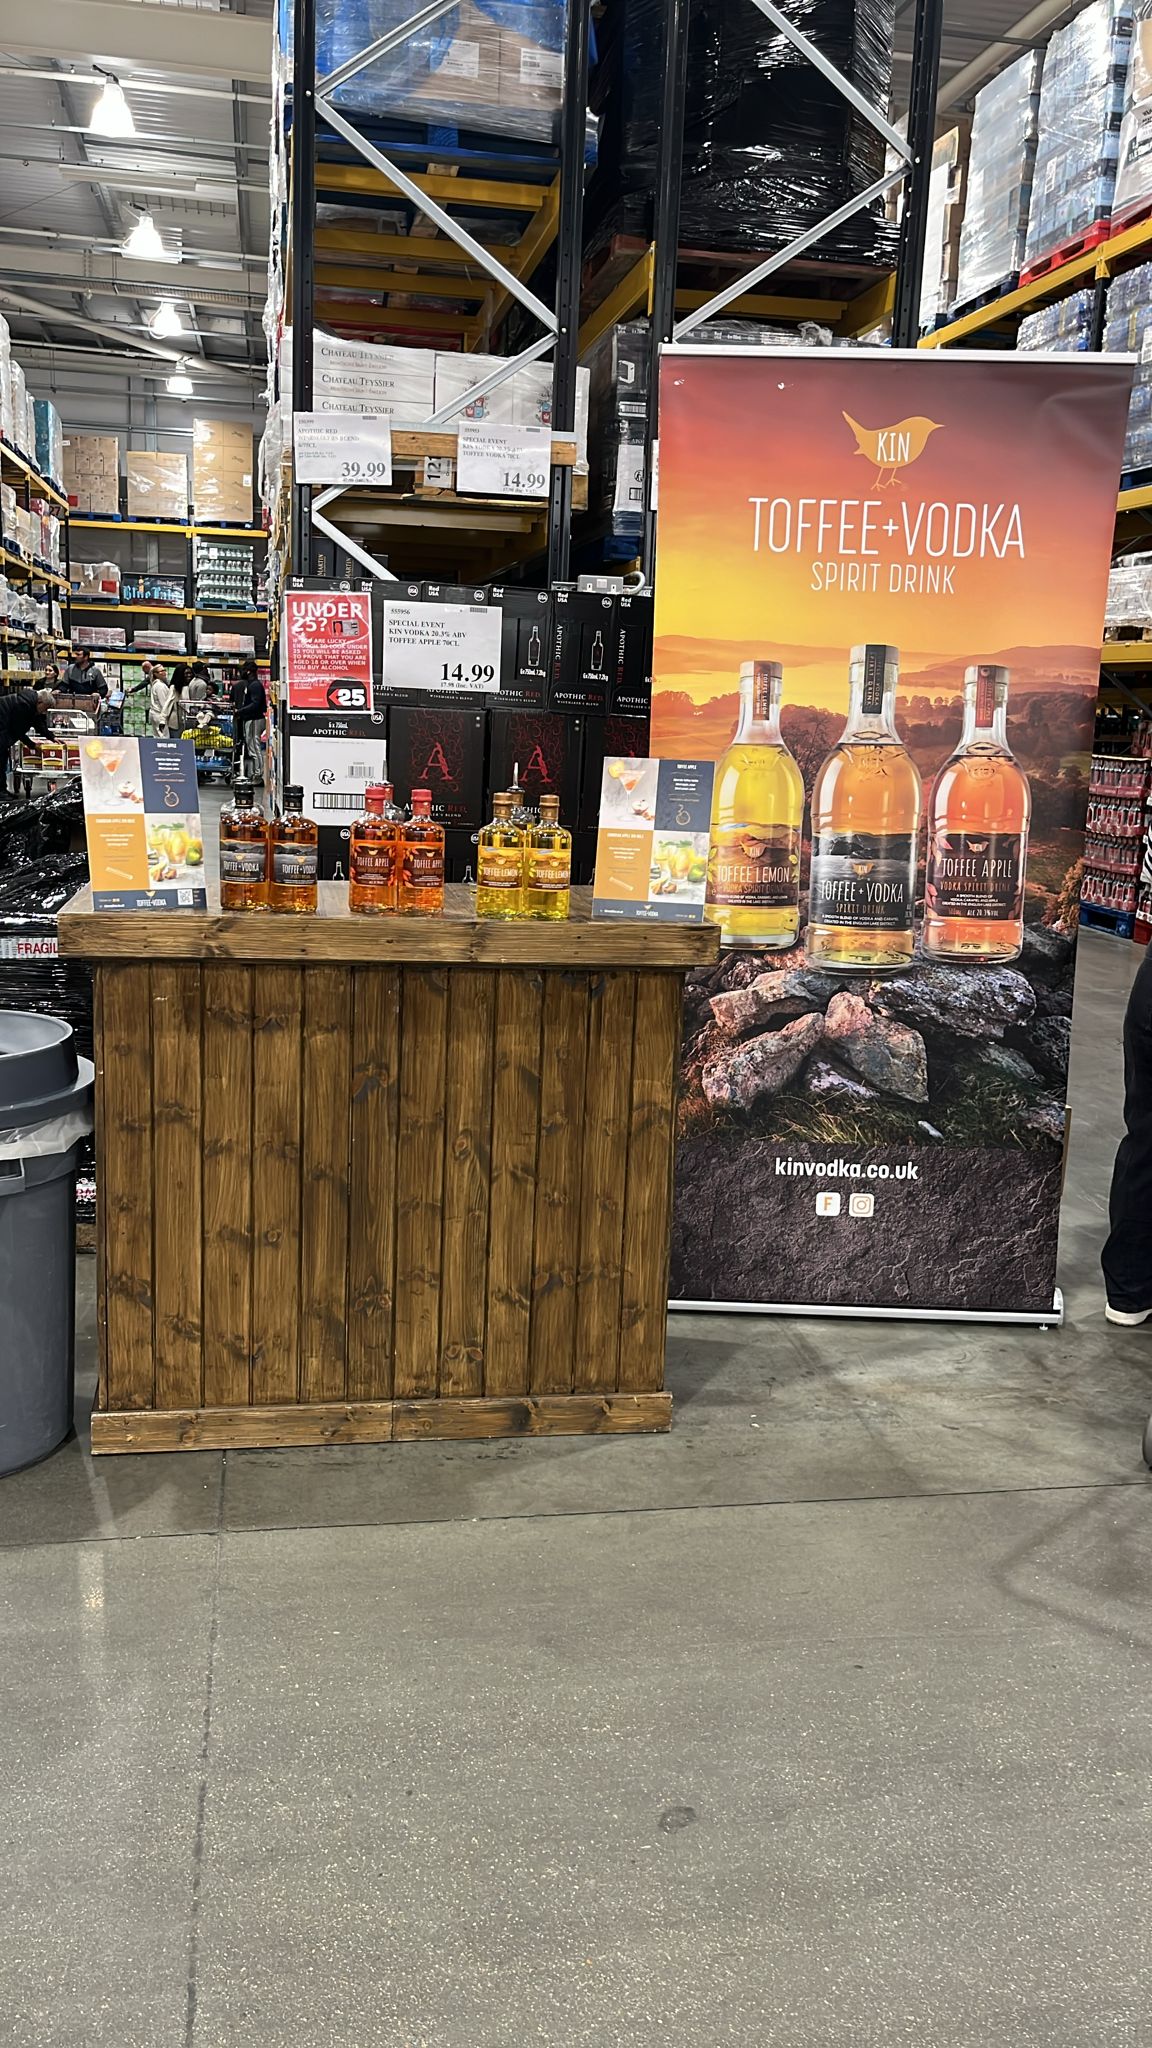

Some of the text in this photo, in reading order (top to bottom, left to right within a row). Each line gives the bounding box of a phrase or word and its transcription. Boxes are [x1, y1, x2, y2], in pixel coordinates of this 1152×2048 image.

[321, 348, 356, 358] CHATEAU
[322, 374, 394, 388] CHATEAU TEYSSIER
[322, 401, 394, 414] CHATEAU TEYSSIER
[876, 432, 910, 462] KIN
[342, 462, 386, 477] 39.99
[504, 472, 546, 488] 14.99
[748, 497, 1025, 559] TOFFEE+VODKA
[811, 562, 956, 594] SPIRIT DRINK
[292, 601, 363, 618] UNDER
[292, 617, 328, 632] 25?
[555, 624, 564, 659] APOTHIC
[618, 628, 627, 664] APOTHIC
[441, 663, 494, 682] 14.99
[338, 689, 365, 706] 25
[554, 692, 586, 700] APOTHIC
[617, 696, 648, 704] APOTHIC
[224, 860, 259, 872] TOFFEE VODKA
[282, 864, 299, 873] TOFFEE
[357, 857, 389, 867] TOFFEE APPLE
[414, 859, 430, 868] TOFFEE
[942, 858, 1011, 877] TOFFEE APPLE
[501, 868, 518, 876] LEMON
[536, 870, 554, 878] TOFFEE
[718, 865, 790, 882] TOFFEE LEMON
[821, 880, 856, 901] TOFFEE
[867, 883, 903, 903] VODKA
[940, 881, 960, 890] VODKA
[964, 882, 986, 891] SPIRIT
[836, 903, 885, 914] SPIRIT DRINK
[17, 943, 58, 954] FRAGIL
[775, 1157, 919, 1179] kinvodka.co.uk
